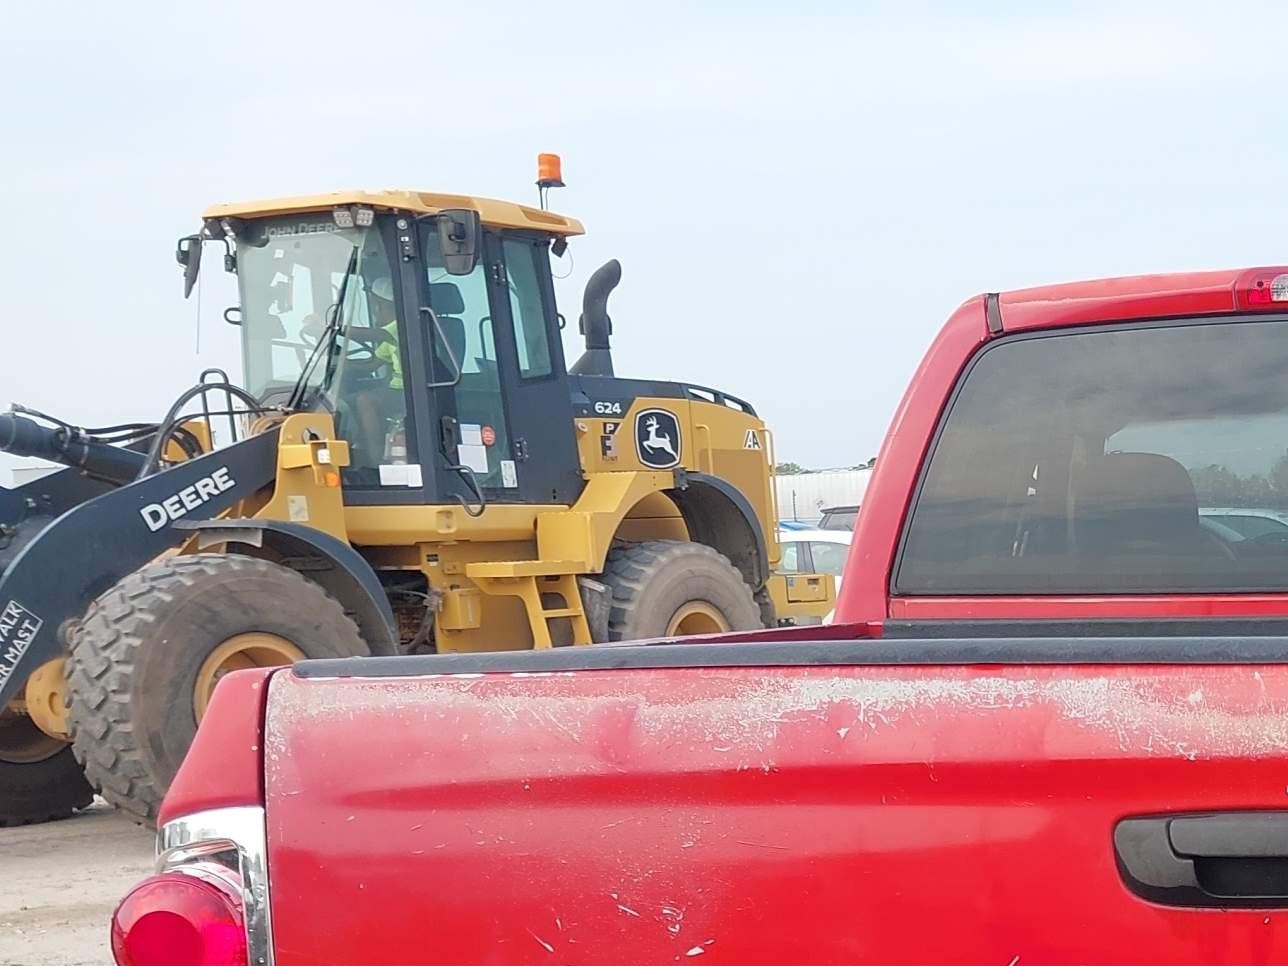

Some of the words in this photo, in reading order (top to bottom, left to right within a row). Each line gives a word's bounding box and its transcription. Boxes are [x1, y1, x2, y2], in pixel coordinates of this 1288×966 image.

[594, 401, 622, 414] 624
[139, 466, 236, 532] DEERE
[3, 619, 36, 663] MAST
